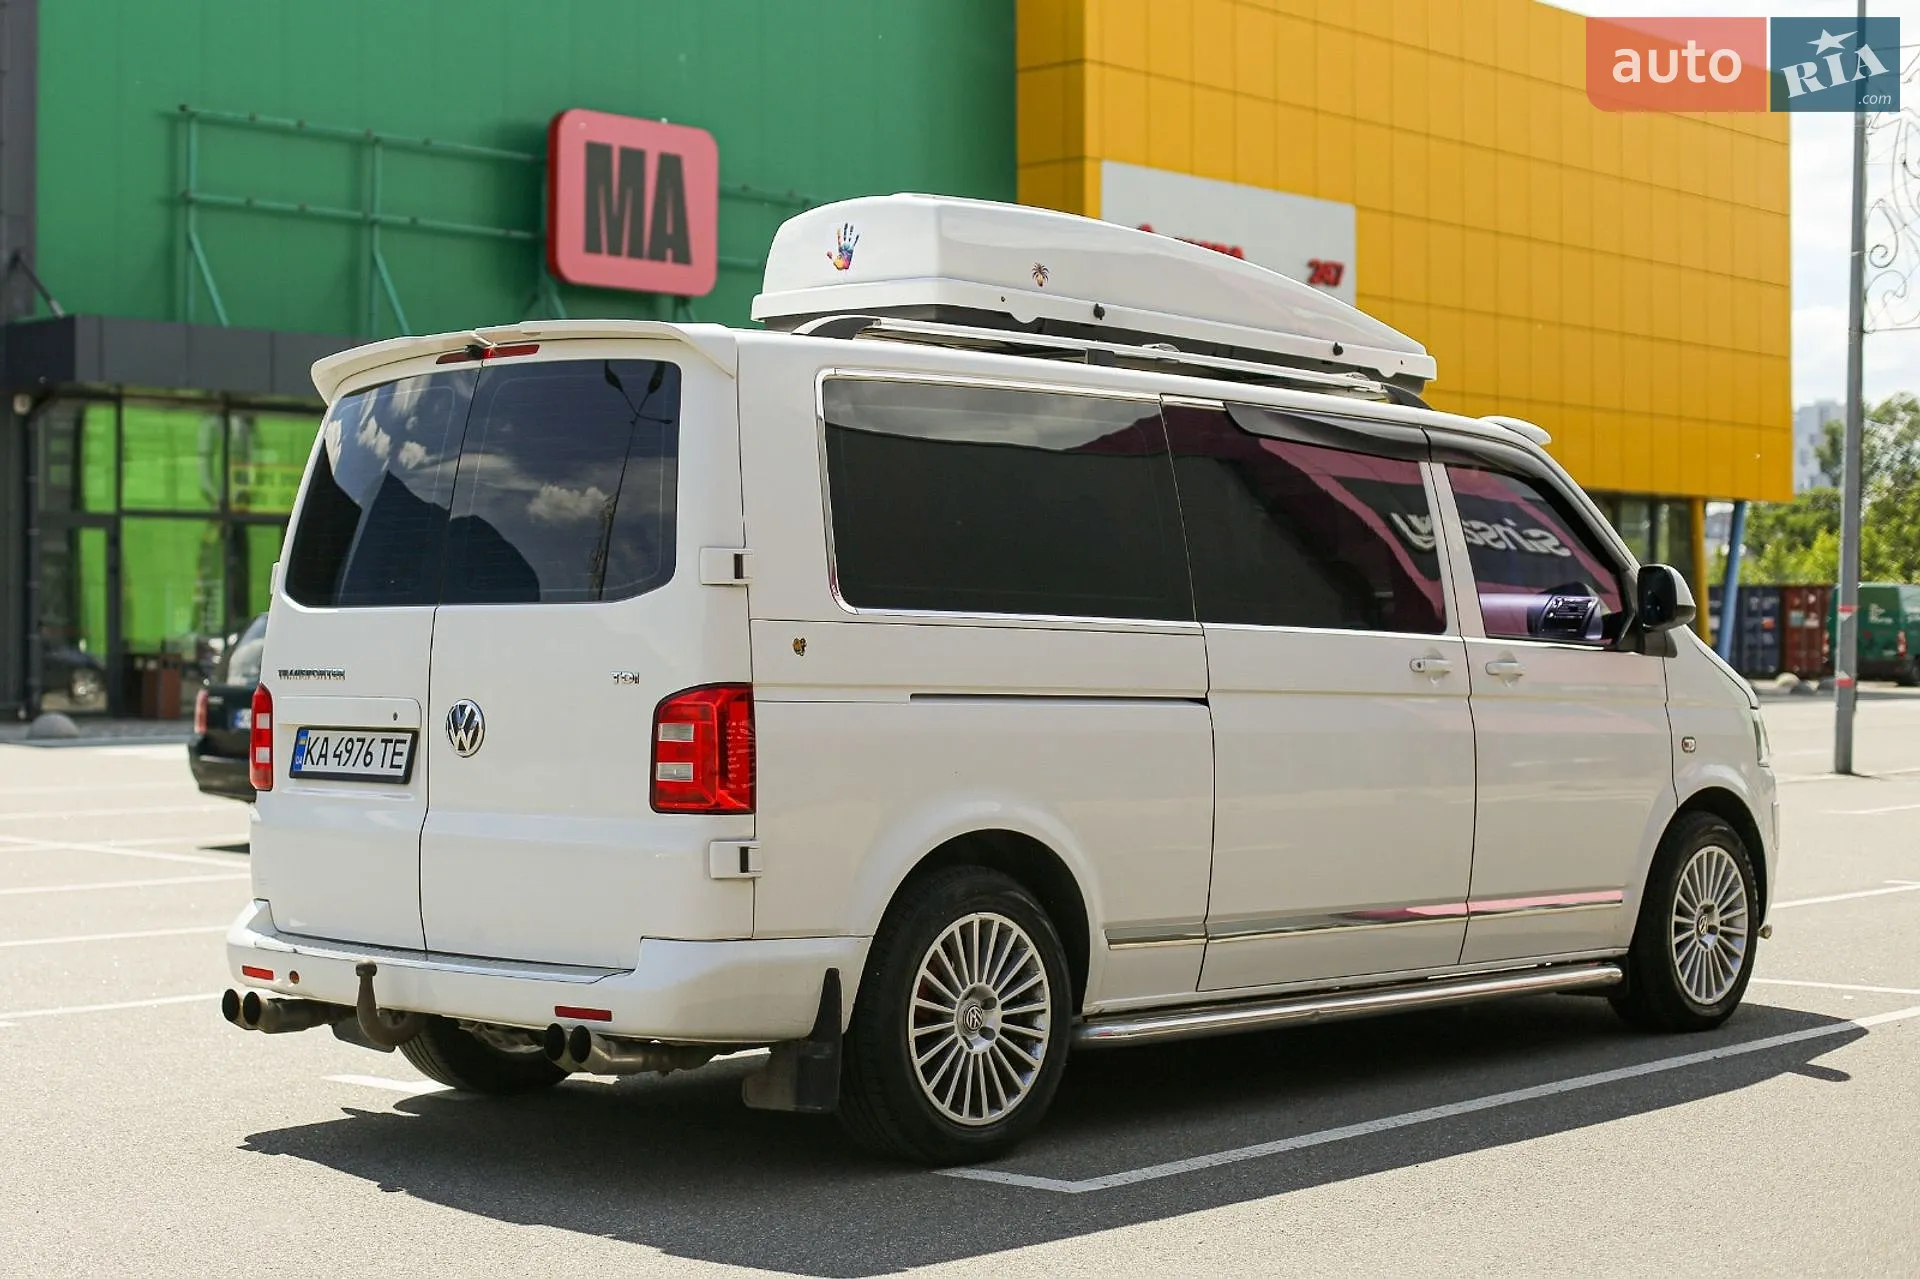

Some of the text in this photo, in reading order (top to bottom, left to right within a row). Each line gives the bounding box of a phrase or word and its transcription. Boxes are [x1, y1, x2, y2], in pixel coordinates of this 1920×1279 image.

[583, 140, 692, 267] MA
[303, 736, 408, 770] KA 4976 TE
